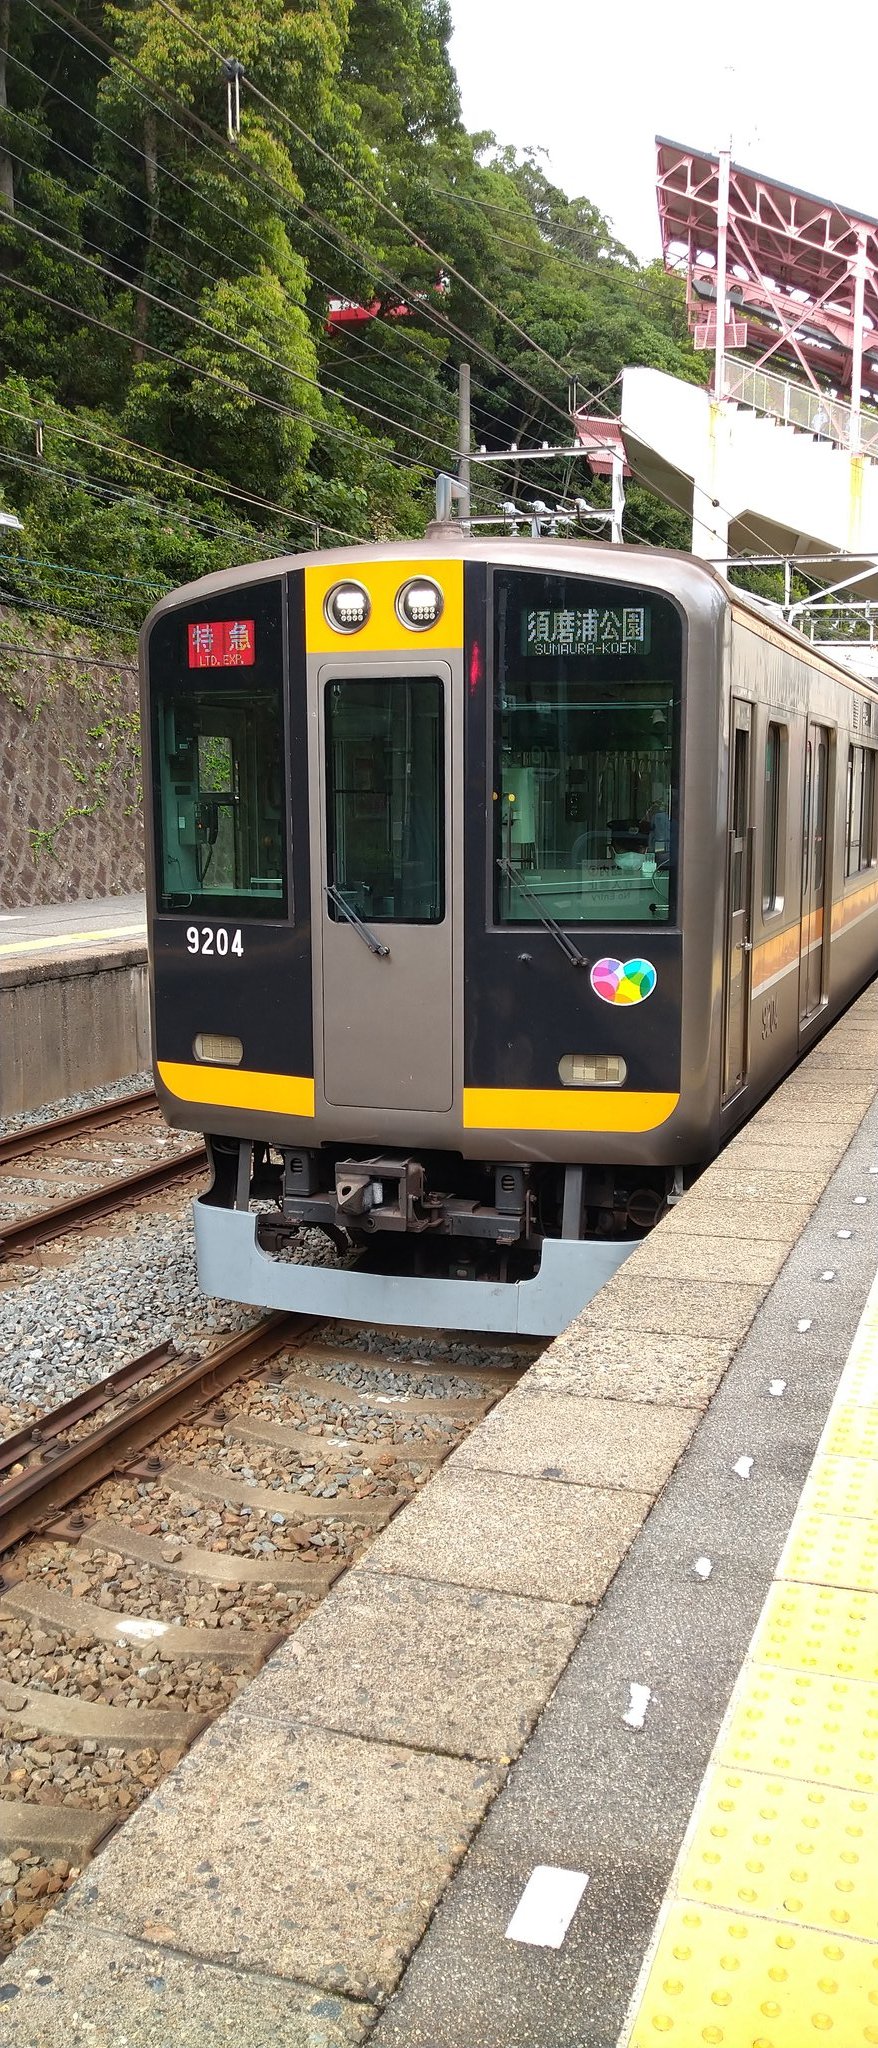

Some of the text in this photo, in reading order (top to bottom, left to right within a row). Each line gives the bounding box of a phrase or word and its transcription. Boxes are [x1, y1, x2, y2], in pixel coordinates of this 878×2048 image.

[192, 622, 251, 653] 特急
[527, 608, 645, 642] 須磨浦公園
[199, 653, 244, 666] LTD. EXP.
[534, 642, 637, 656] SUMAURA-KOEN
[186, 926, 244, 957] 9204
